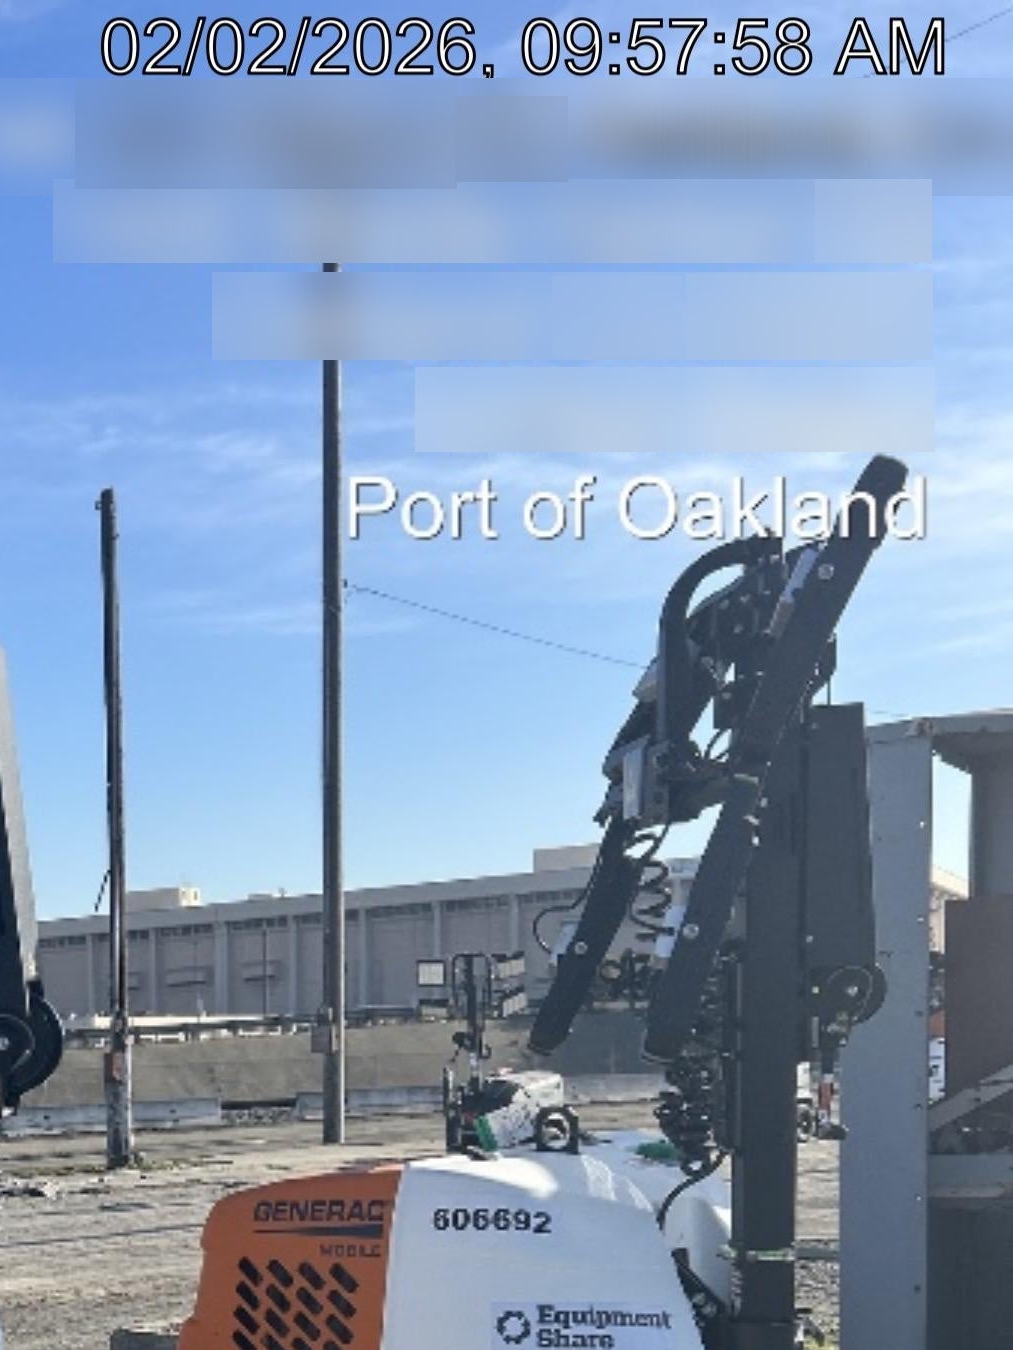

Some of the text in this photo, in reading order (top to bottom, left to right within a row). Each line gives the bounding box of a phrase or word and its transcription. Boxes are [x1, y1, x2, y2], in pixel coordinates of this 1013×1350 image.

[253, 1200, 384, 1222] GENERAC
[433, 1207, 552, 1234] 606692
[320, 1243, 381, 1258] MOBILE
[537, 1304, 672, 1329] Equipment
[537, 1328, 615, 1349] Share
